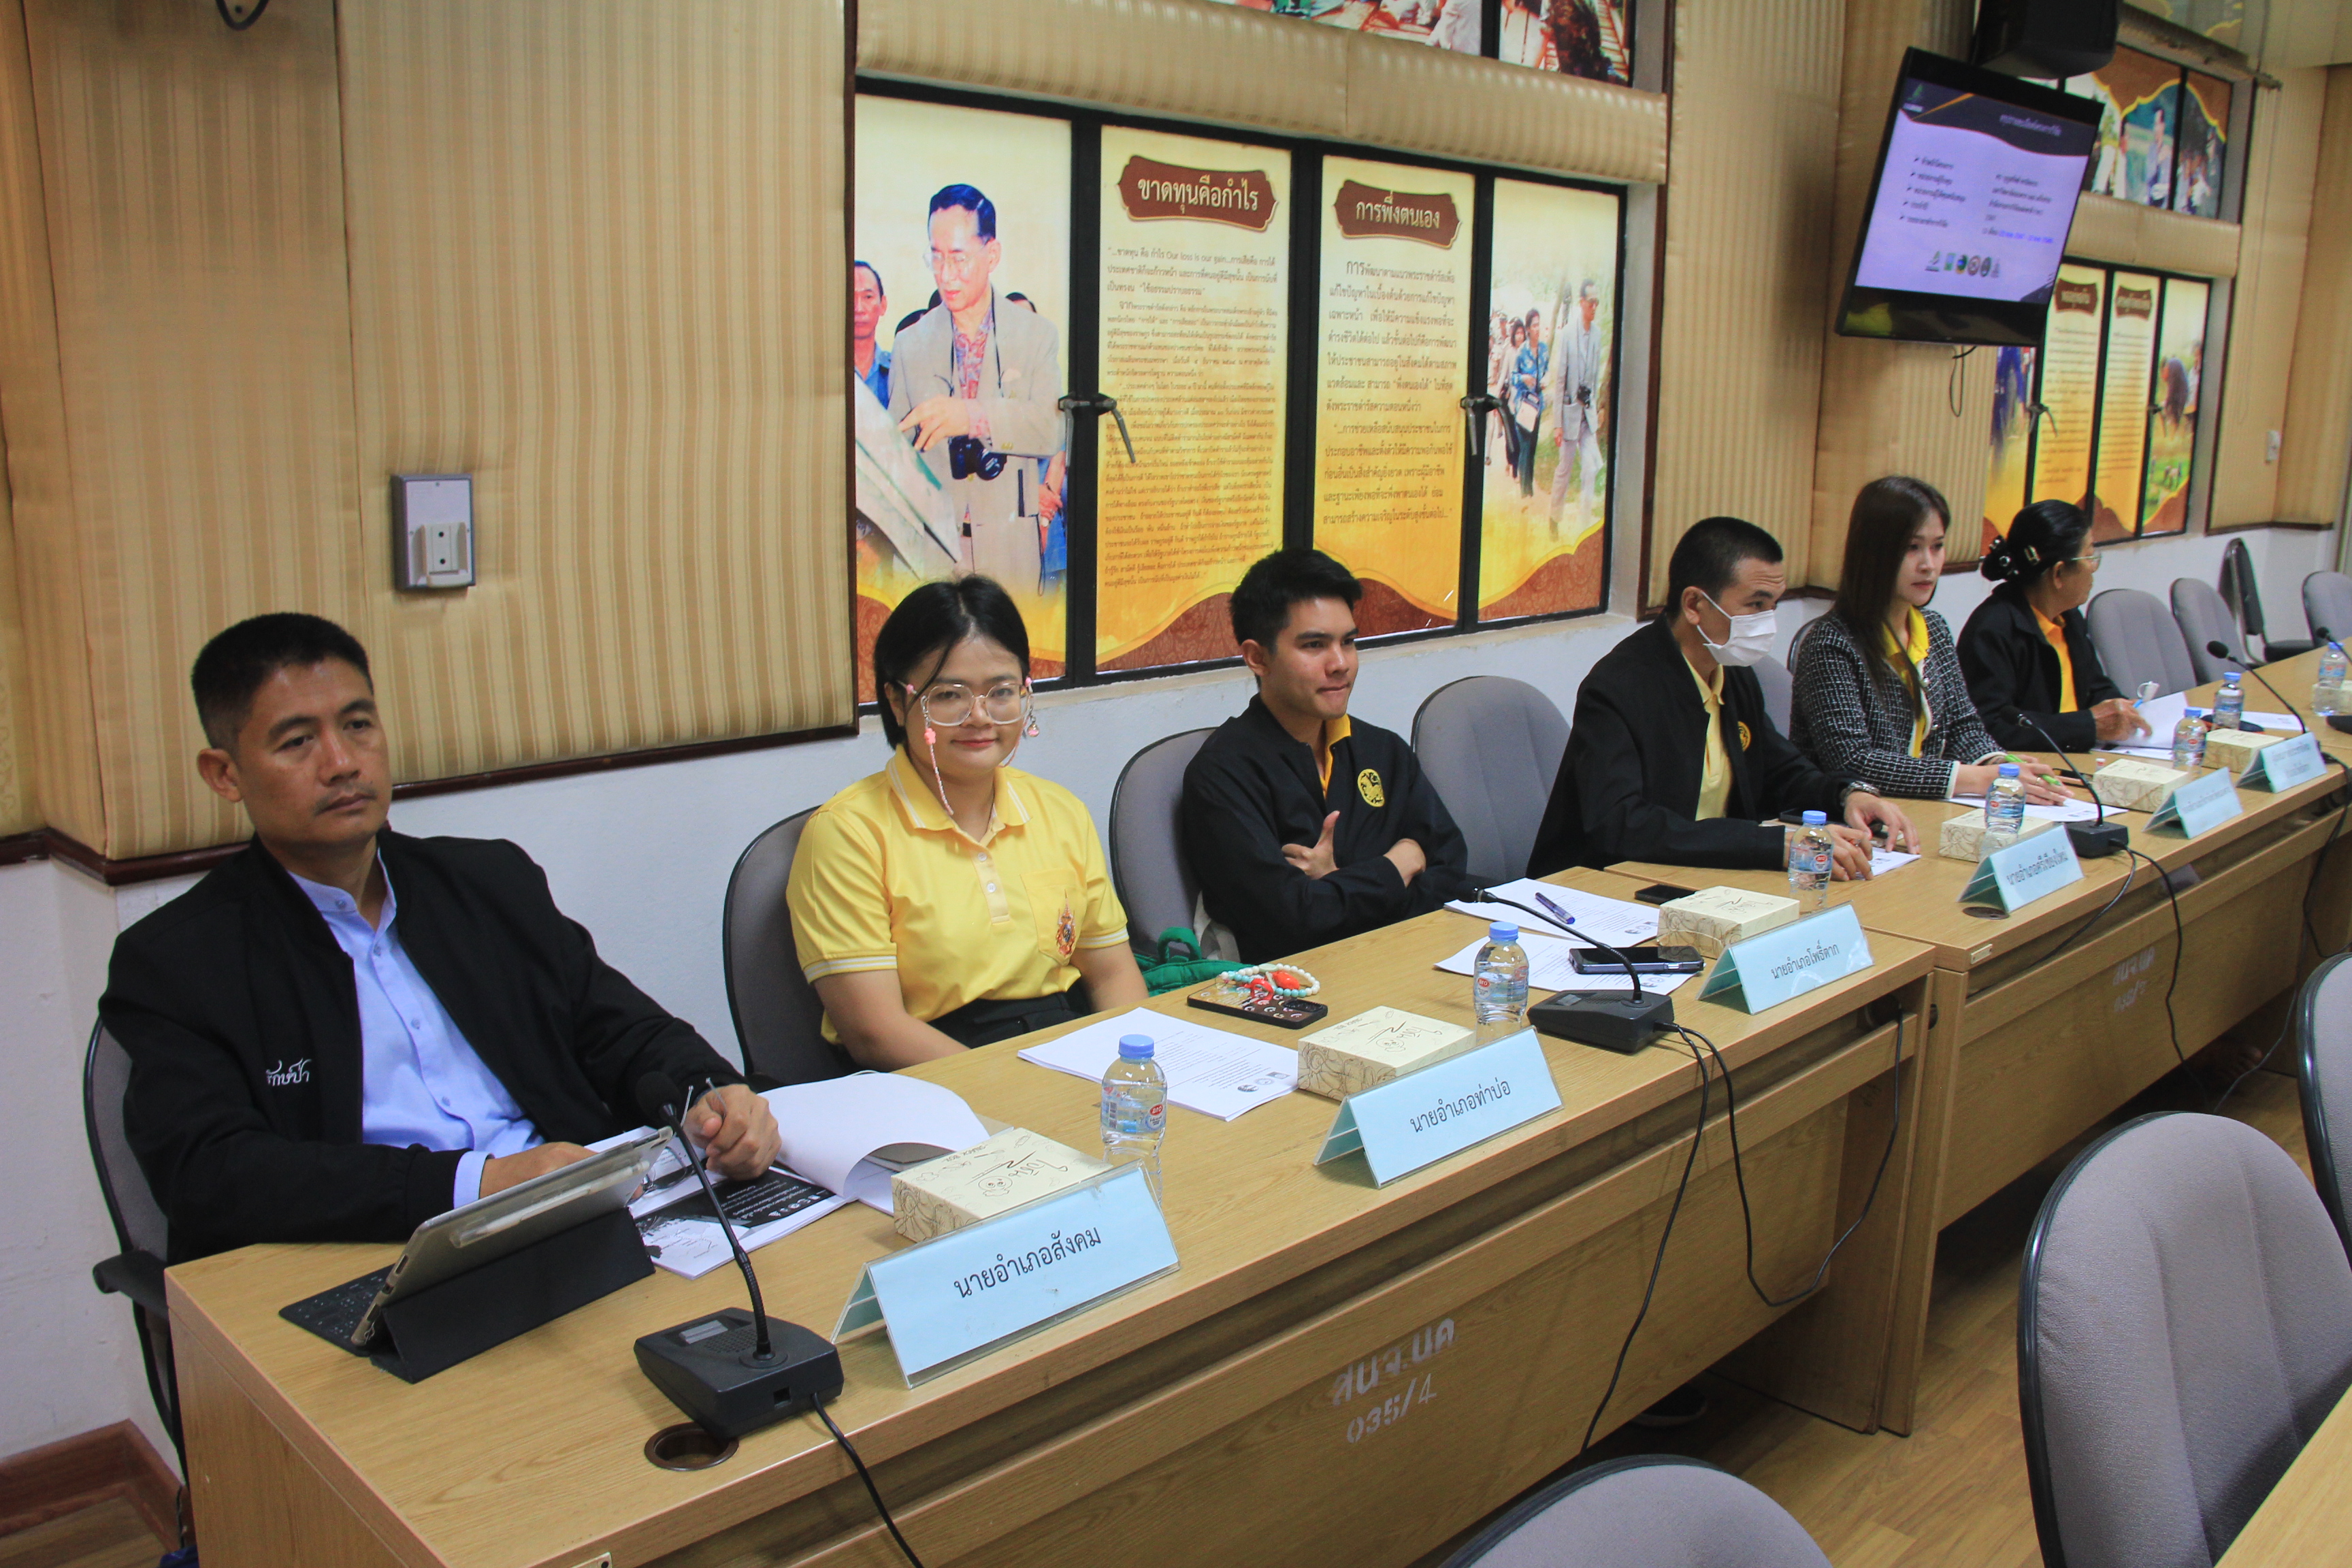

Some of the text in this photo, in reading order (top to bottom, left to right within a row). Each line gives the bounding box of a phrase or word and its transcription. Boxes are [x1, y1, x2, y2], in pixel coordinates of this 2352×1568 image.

[1137, 174, 1258, 214] ขาดทุนคือกำไร
[1356, 190, 1440, 229] การพึ่งตนเอง
[1770, 938, 1840, 981] นายอำเภอโพธิ์ตาก
[1152, 1105, 1162, 1114] aro
[1409, 1077, 1512, 1135] นายอำเภอท่าบ่อ
[953, 1227, 1102, 1299] นายอำเภอสังคม
[1346, 1373, 1437, 1443] 035/4
